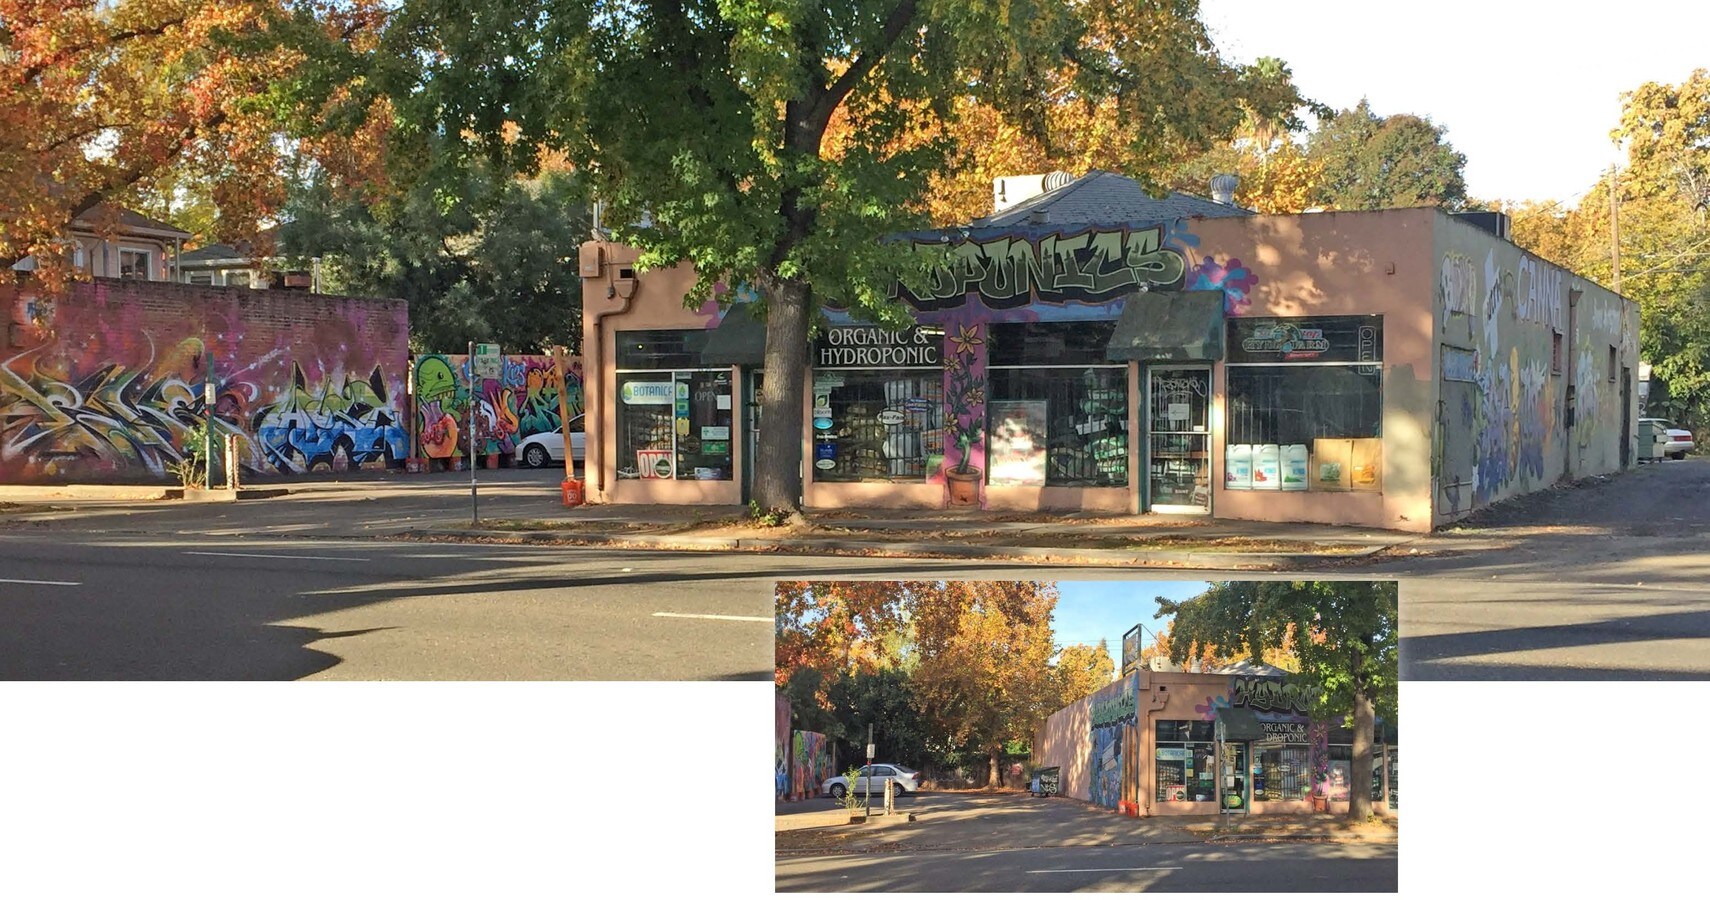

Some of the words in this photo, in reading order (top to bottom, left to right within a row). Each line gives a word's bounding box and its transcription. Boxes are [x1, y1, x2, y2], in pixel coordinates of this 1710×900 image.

[829, 328, 908, 346] ORGANIC
[914, 327, 929, 344] &
[821, 346, 937, 365] HYDROPONIC
[1266, 732, 1308, 743] DROPONIC
